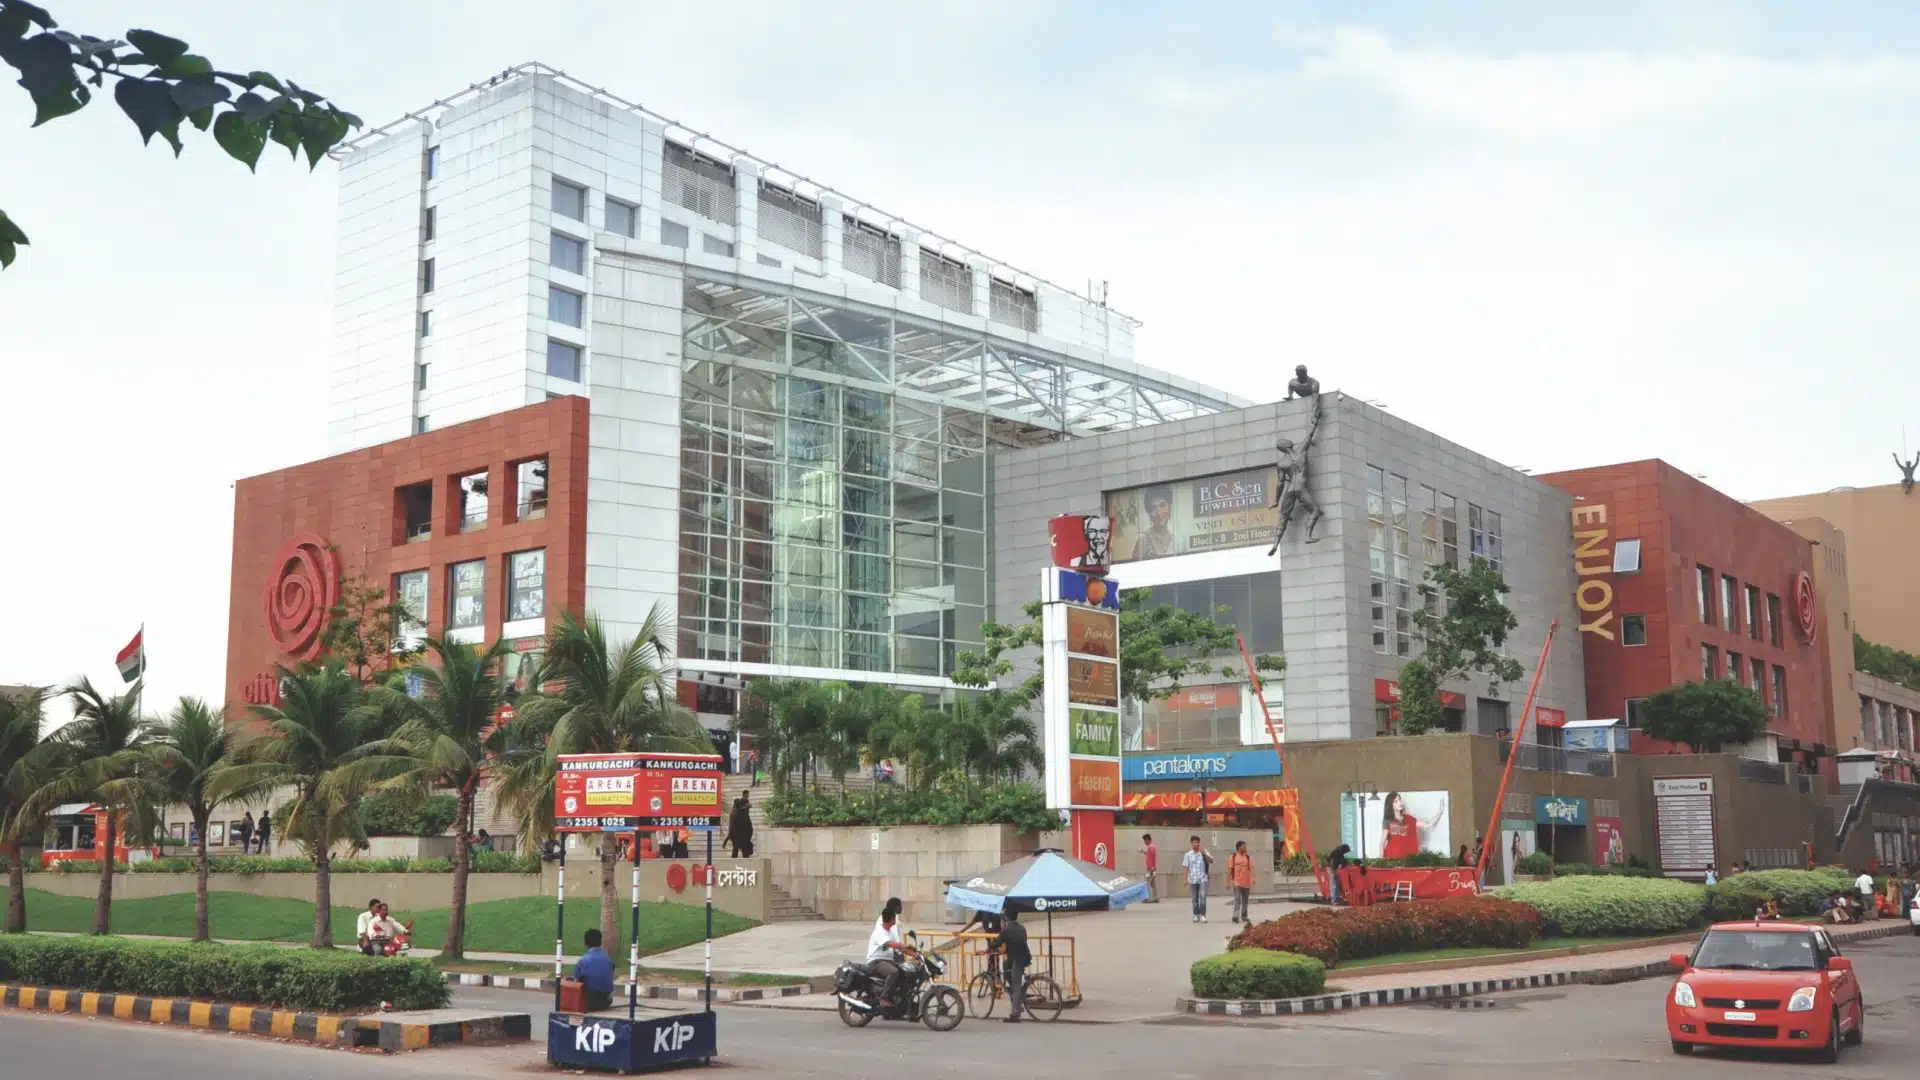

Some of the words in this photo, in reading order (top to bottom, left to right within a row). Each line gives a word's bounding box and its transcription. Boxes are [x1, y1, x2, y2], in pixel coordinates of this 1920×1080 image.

[1200, 497, 1263, 514] JEWELLERS
[1192, 535, 1213, 546] Bloc
[1572, 504, 1615, 641] ENJOY
[1076, 723, 1113, 743] FAMILY
[562, 759, 634, 771] KANKURGACHI
[646, 760, 717, 770] KANKURGACHI
[1144, 754, 1226, 779] pantaloons
[588, 779, 632, 790] ARENA
[674, 779, 716, 791] ARENA
[1079, 775, 1112, 792] FRIEND
[575, 818, 599, 827] 2355
[601, 817, 625, 827] 1025
[660, 817, 684, 826] 2355
[687, 817, 710, 826] 1025
[718, 864, 757, 887] সেন্টার
[1048, 899, 1077, 908] MOCHI
[575, 1022, 616, 1053] KIP
[654, 1020, 695, 1053] KIP
